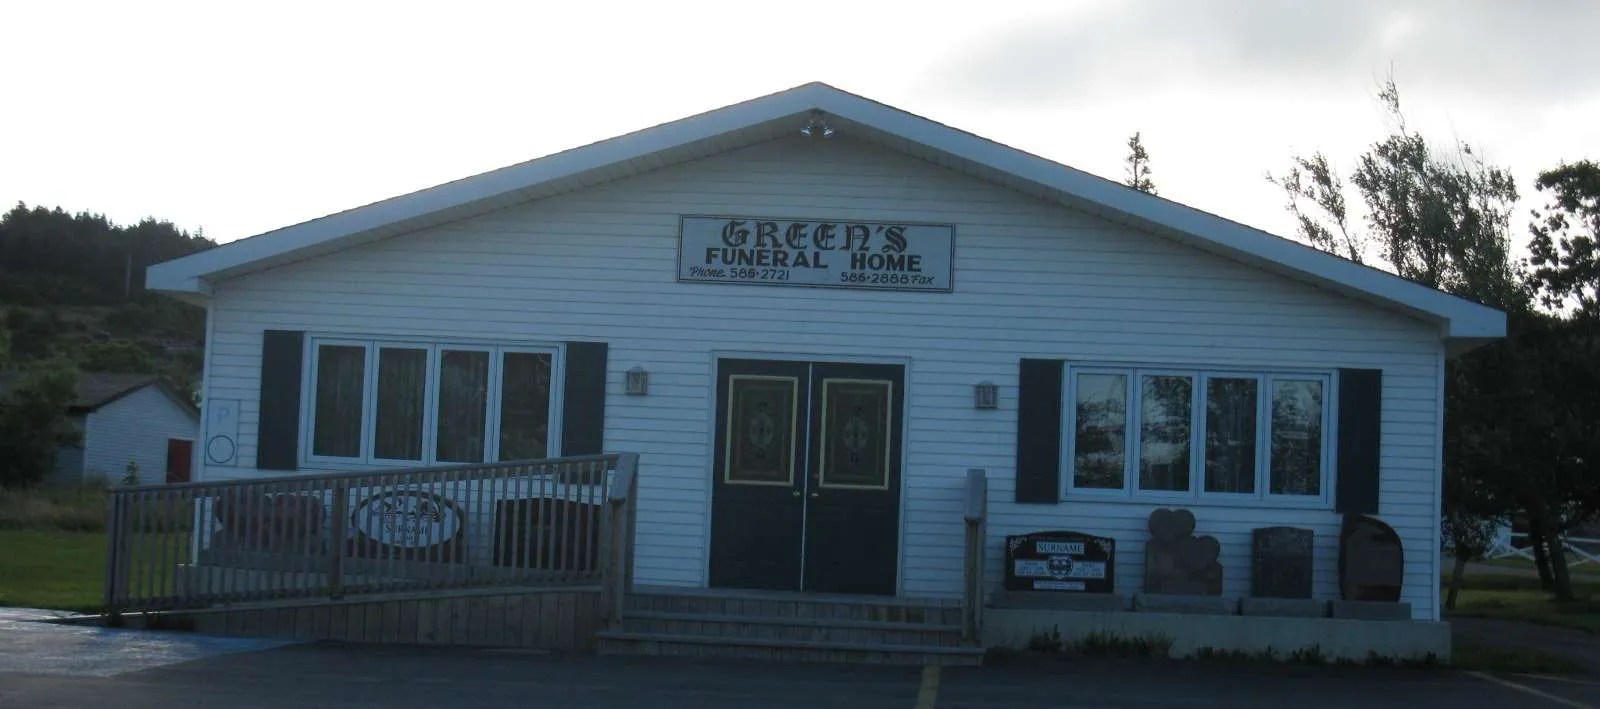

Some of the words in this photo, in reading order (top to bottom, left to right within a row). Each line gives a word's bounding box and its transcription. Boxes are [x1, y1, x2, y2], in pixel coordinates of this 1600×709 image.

[722, 220, 908, 253] GREEN'S
[705, 247, 828, 269] FUNERAL
[850, 252, 922, 272] HOME
[911, 275, 935, 286] Fax
[1038, 542, 1084, 553] SURNAME
